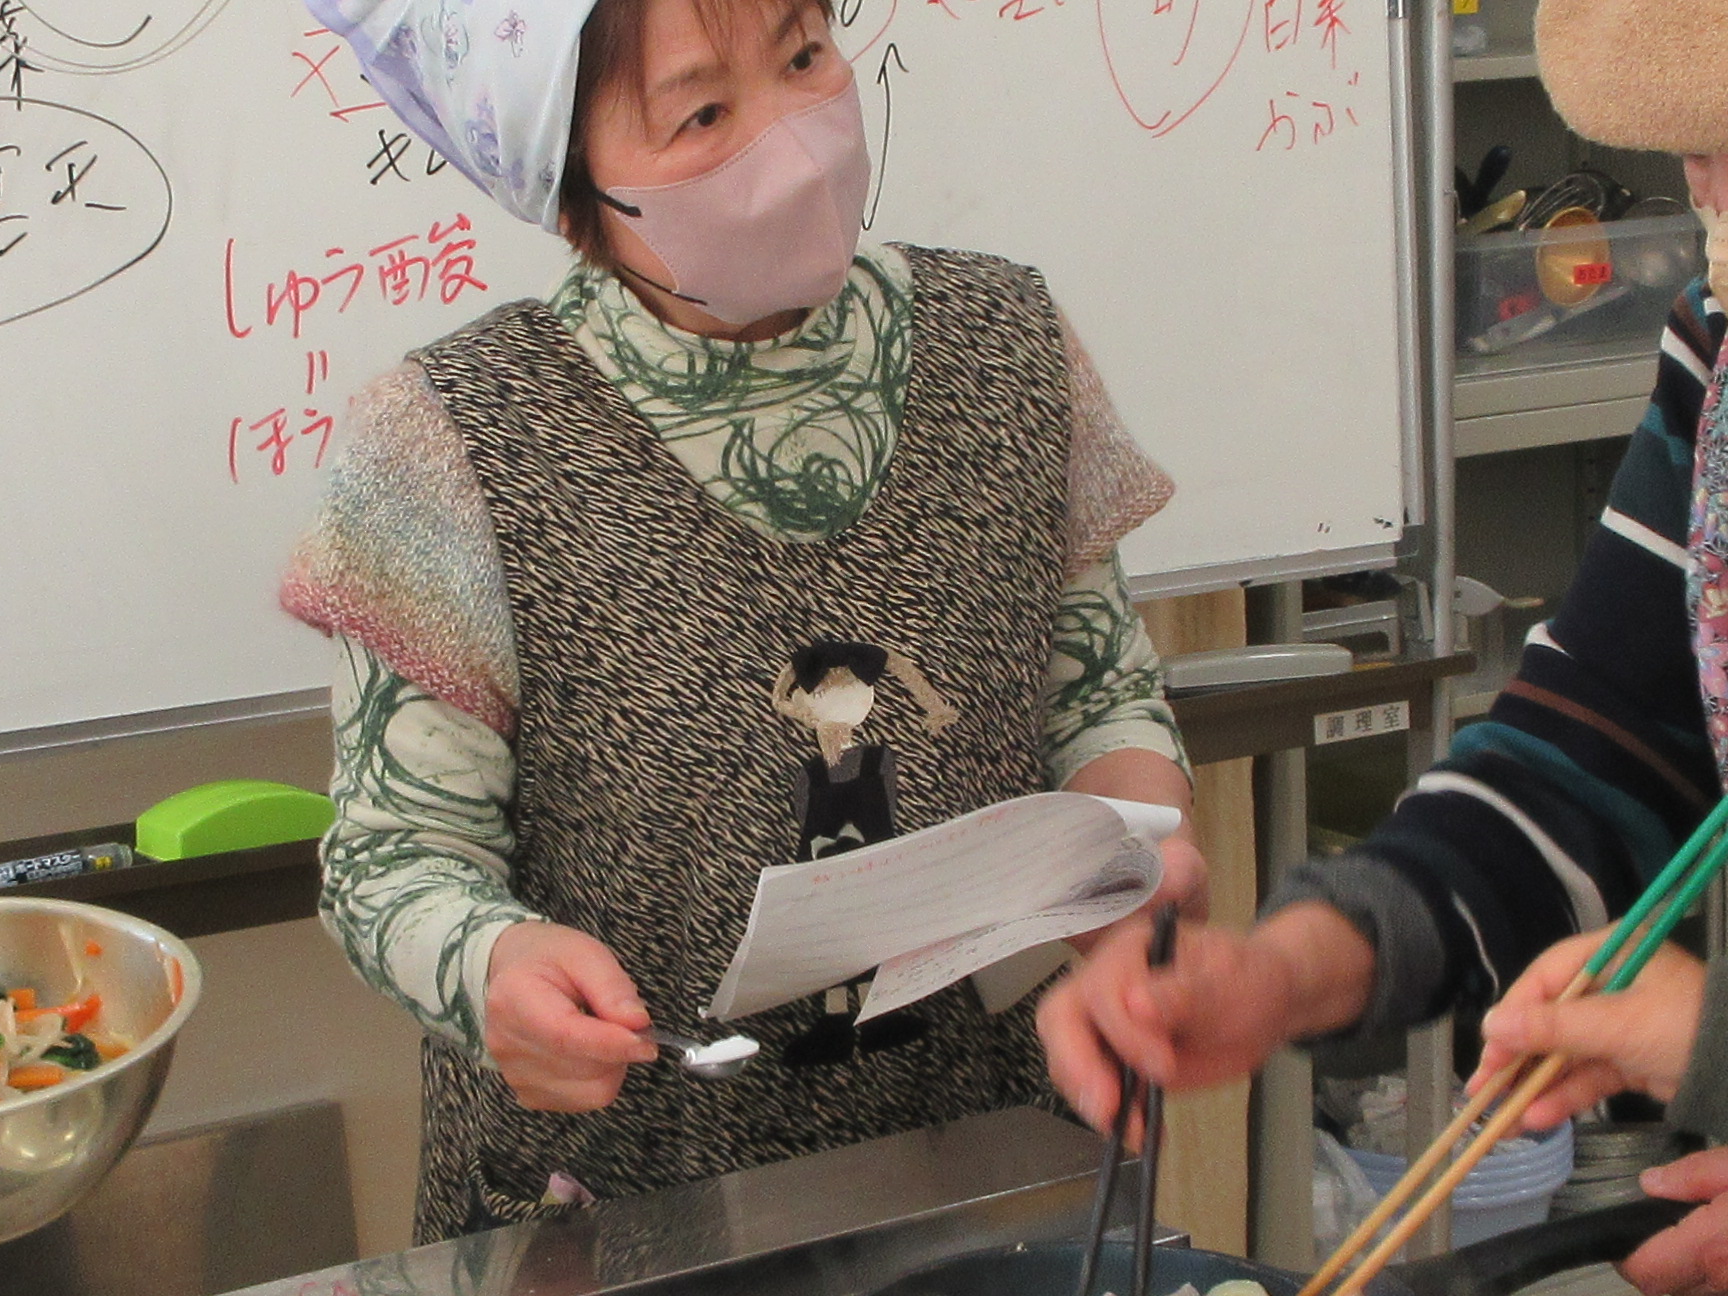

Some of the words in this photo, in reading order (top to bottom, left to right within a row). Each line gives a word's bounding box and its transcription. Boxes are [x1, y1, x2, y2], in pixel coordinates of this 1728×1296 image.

[225, 212, 489, 339] しゅう酸
[228, 407, 335, 484] ほう
[1325, 704, 1401, 740] 調理室
